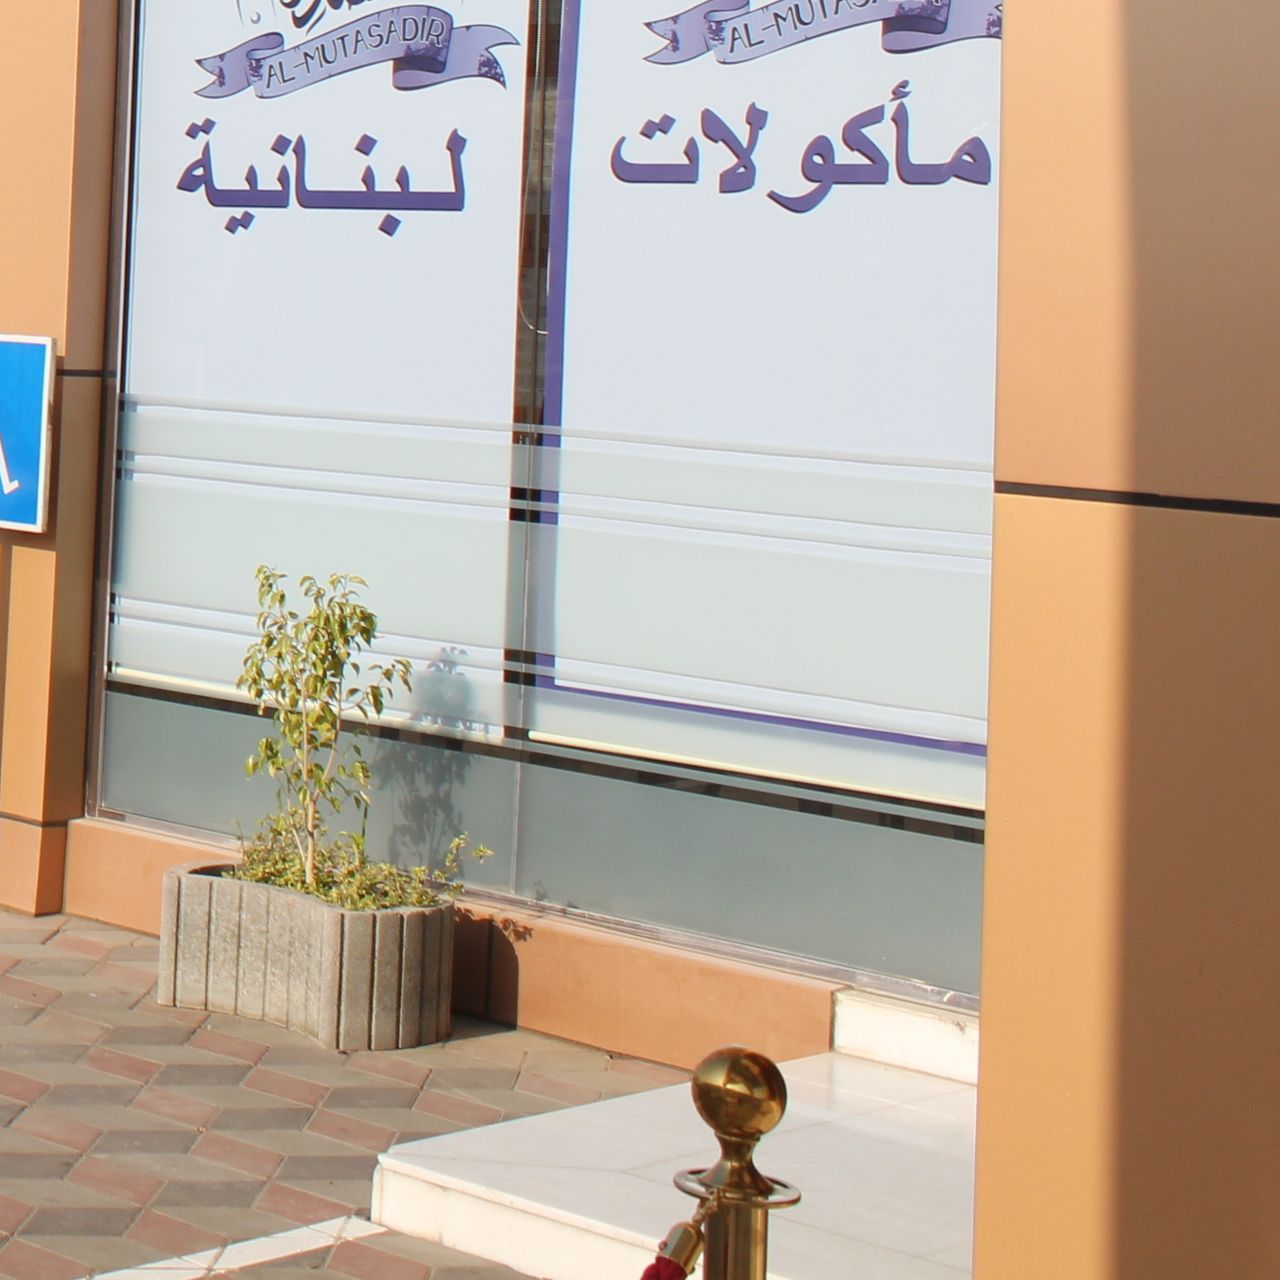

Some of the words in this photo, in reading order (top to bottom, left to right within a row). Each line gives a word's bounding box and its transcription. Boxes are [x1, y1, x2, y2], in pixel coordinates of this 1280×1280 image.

[266, 16, 445, 89] AL-MUTASADIR
[177, 117, 467, 238] لبنانية
[610, 80, 992, 213] مأكولات
